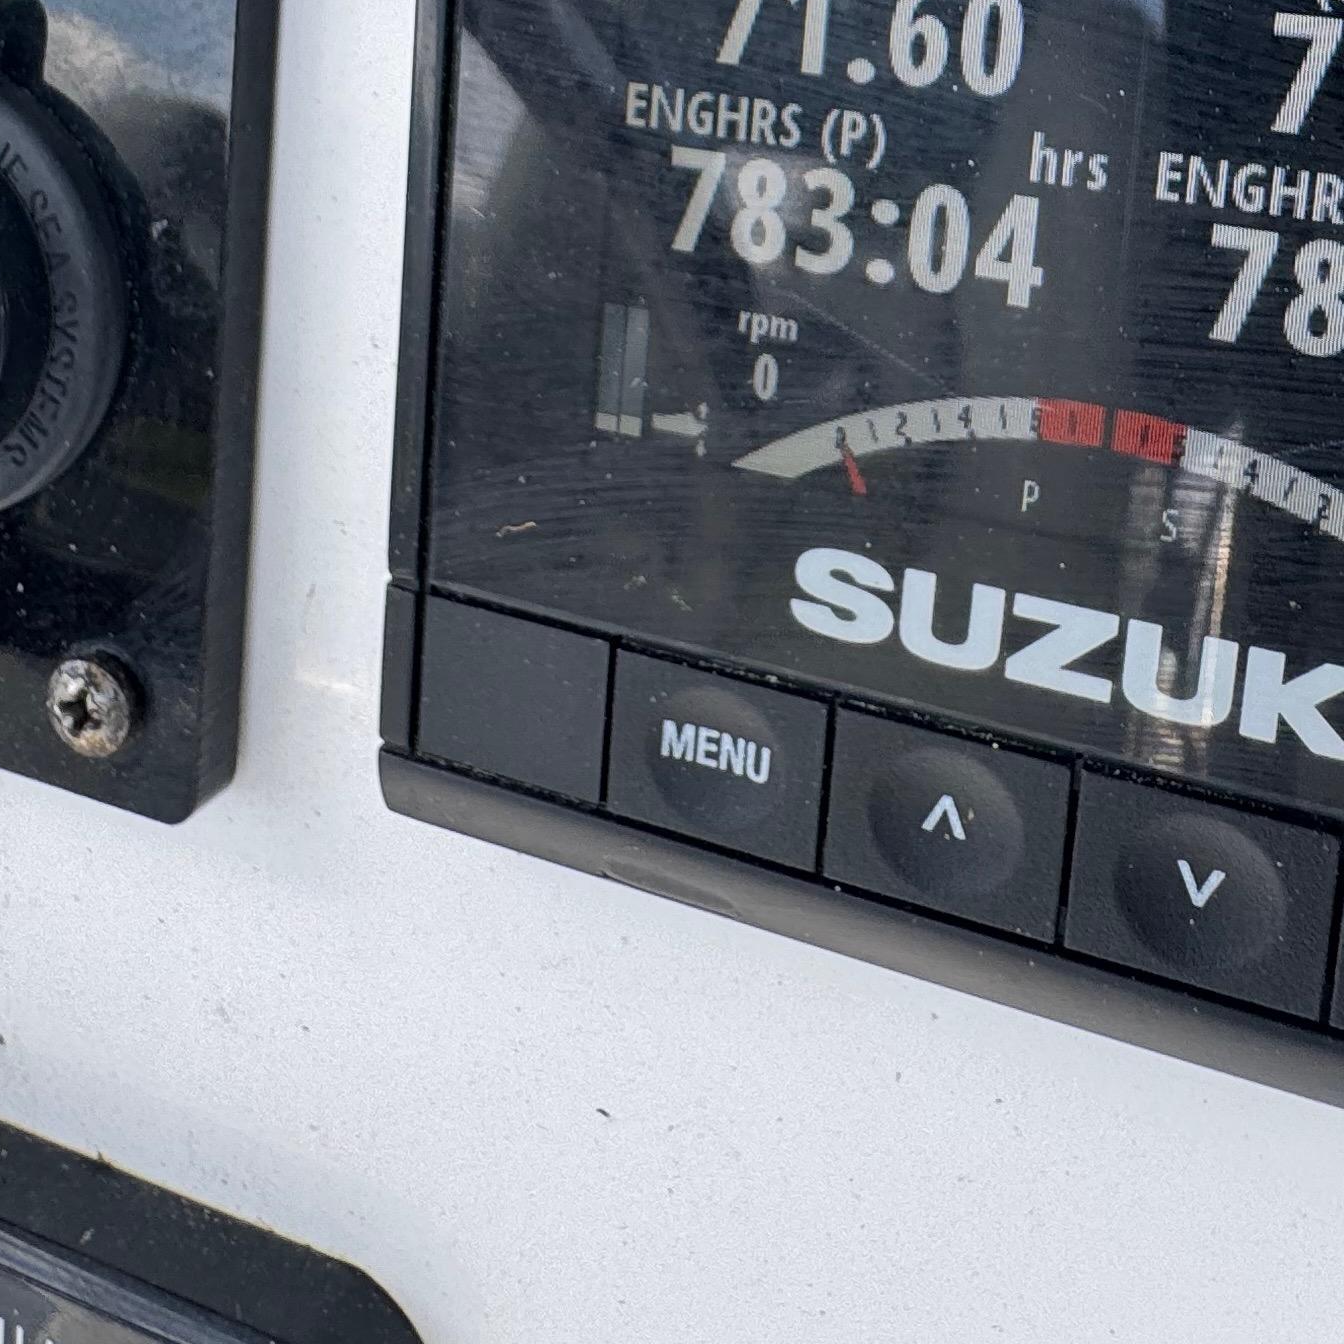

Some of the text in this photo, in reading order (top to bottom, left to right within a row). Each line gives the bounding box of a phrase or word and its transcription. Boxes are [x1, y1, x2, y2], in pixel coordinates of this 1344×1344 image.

[625, 81, 887, 170] ENGHRS (P)
[1029, 130, 1109, 192] hrs
[670, 146, 1045, 310] 783:04
[737, 308, 800, 344] rpm
[752, 353, 779, 403] 0
[1021, 479, 1040, 513] P
[1159, 508, 1178, 543] S
[659, 717, 772, 787] MENU
